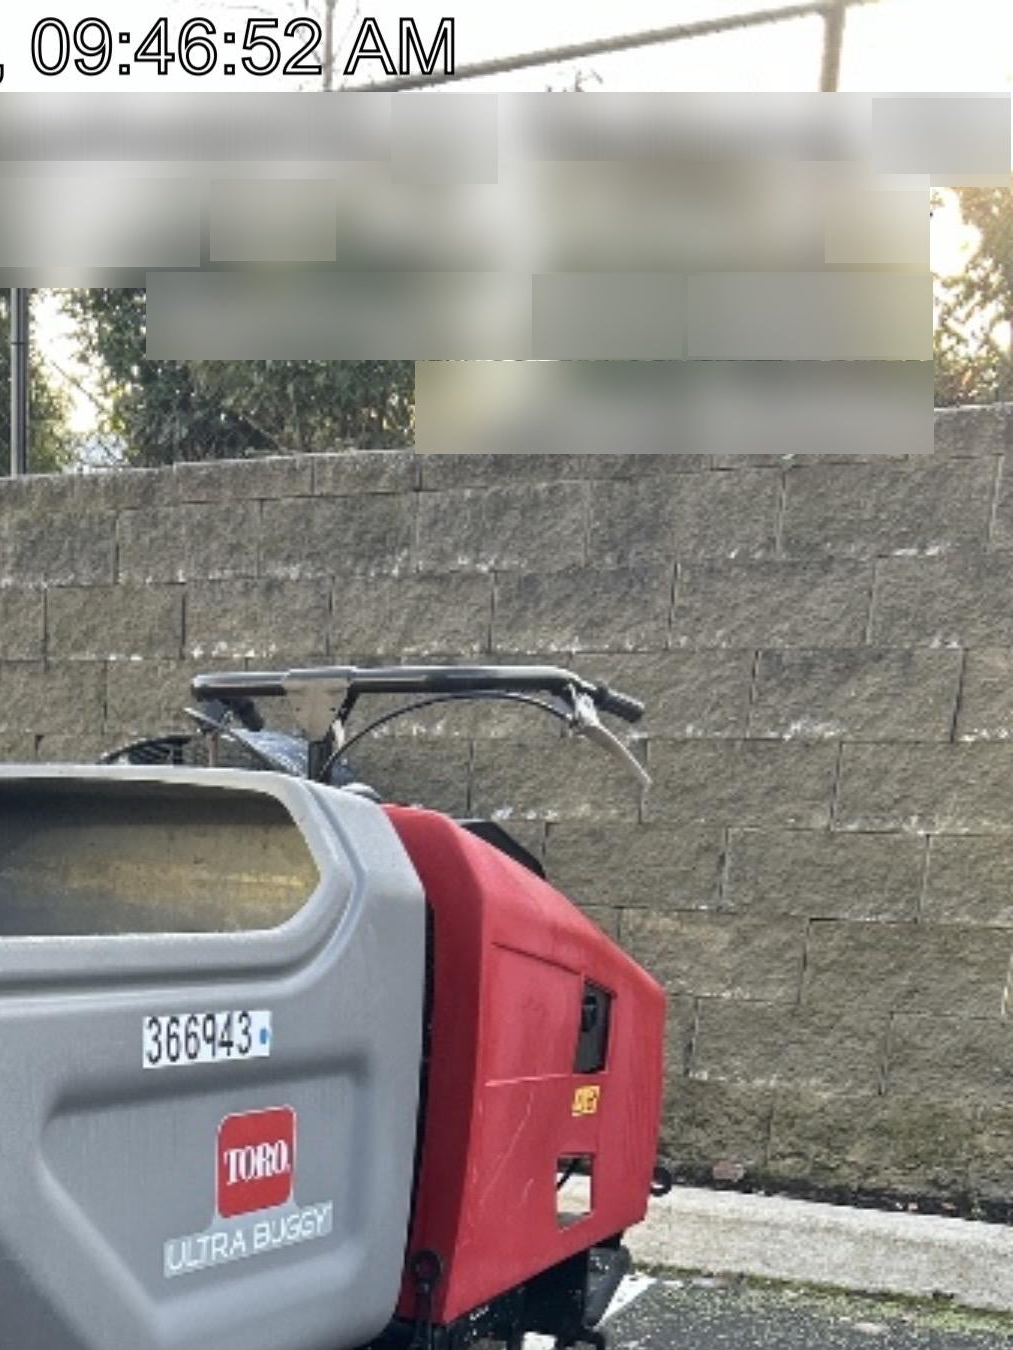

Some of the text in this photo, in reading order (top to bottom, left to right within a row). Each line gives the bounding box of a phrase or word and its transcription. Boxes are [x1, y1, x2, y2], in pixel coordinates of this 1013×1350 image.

[145, 1010, 253, 1065] 366943
[223, 1139, 290, 1186] TORO
[165, 1204, 329, 1272] ULTRA BUGGY
